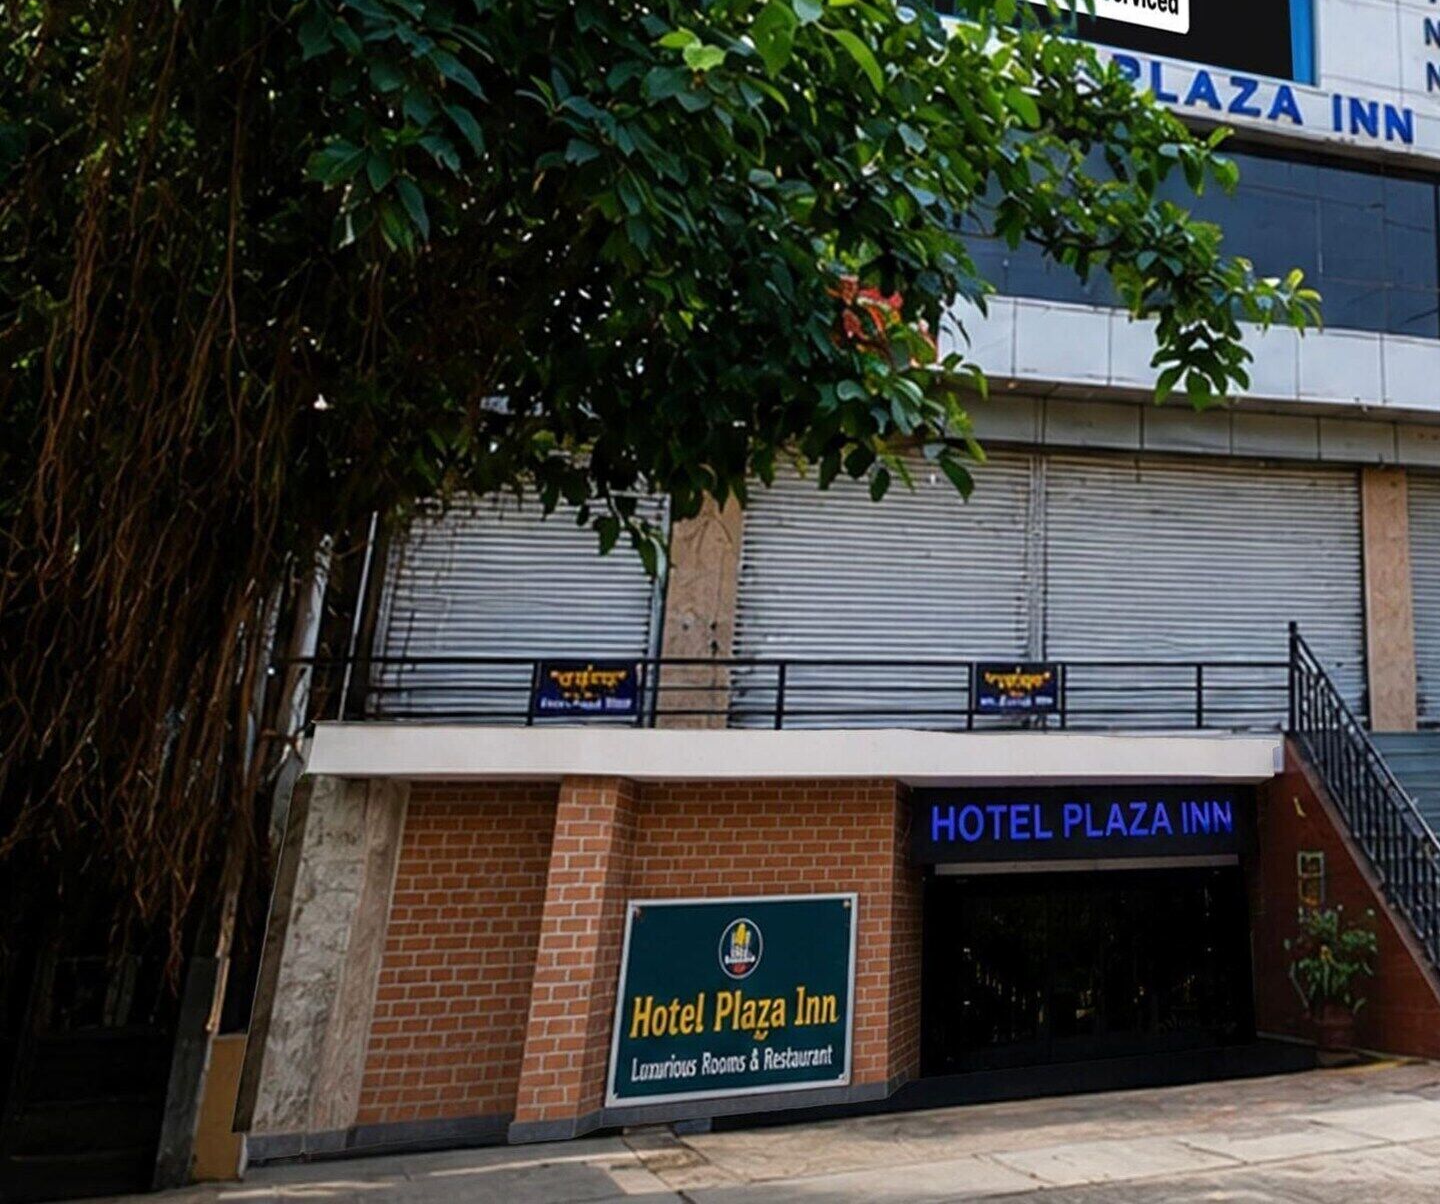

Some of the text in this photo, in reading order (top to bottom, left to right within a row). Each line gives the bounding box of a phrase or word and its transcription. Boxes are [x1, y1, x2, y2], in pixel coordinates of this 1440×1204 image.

[1111, 53, 1414, 144] PLAZA INN
[931, 801, 1233, 842] HOTEL PLAZA INN
[629, 986, 841, 1041] Hotel Plaza Inn
[701, 1052, 746, 1075] Rooms
[750, 1048, 759, 1071] &
[764, 1045, 833, 1070] Restaurant
